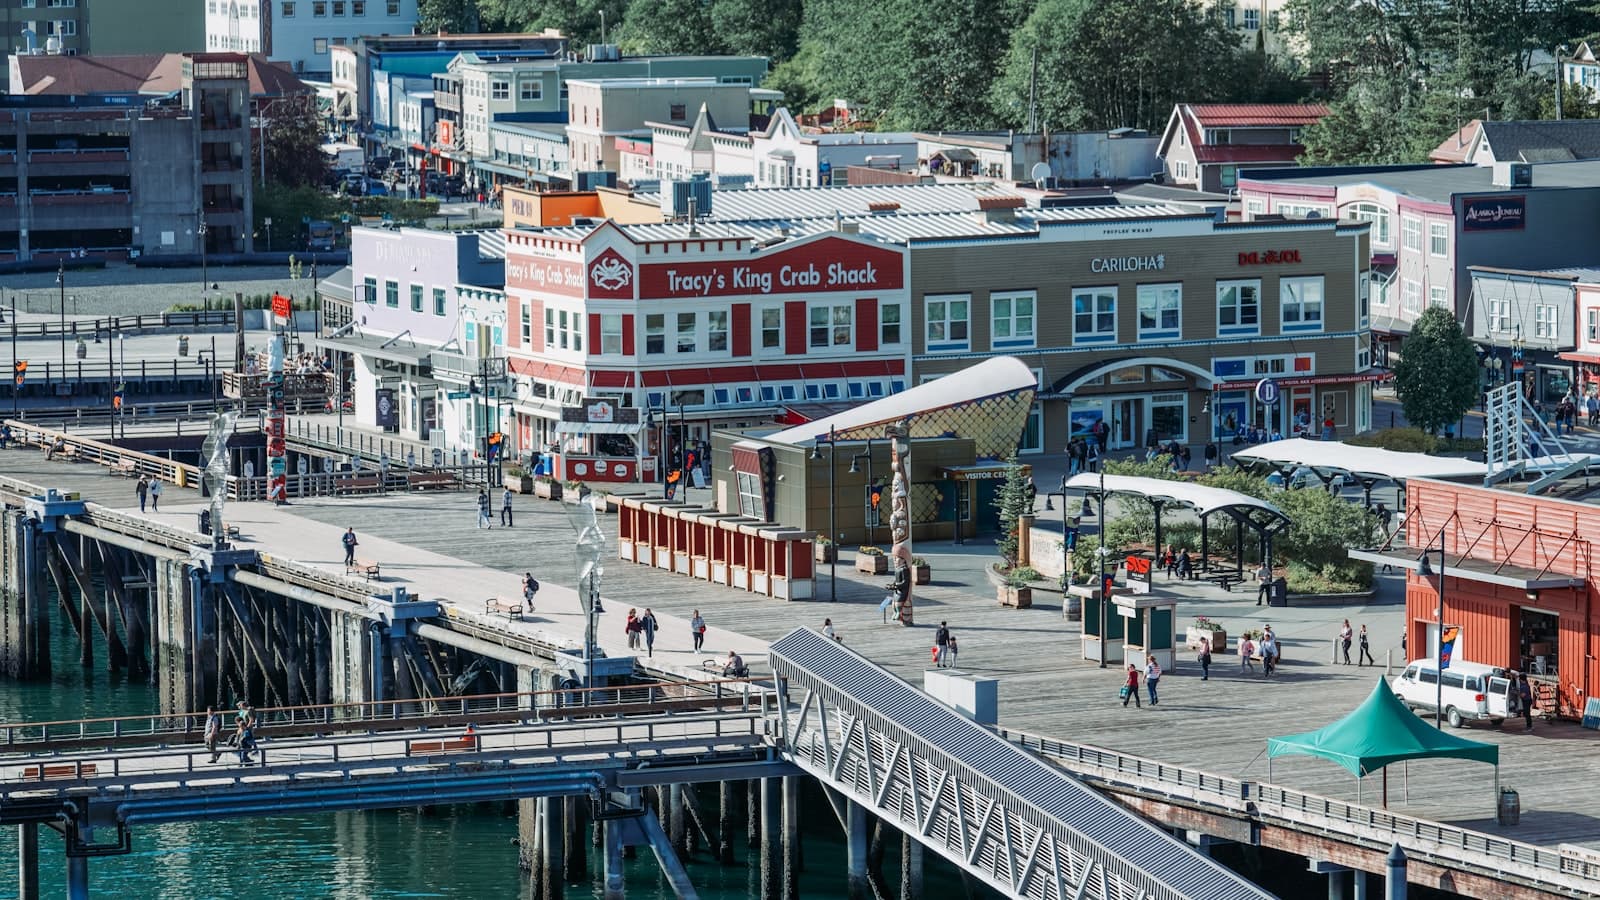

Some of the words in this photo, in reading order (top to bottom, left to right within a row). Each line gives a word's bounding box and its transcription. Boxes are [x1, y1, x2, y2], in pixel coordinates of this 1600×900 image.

[512, 198, 525, 216] PIER
[1091, 256, 1157, 273] CARILOHA
[507, 259, 528, 283] Tracy's
[530, 263, 545, 287] King
[546, 264, 563, 285] Crab
[564, 266, 584, 288] Shack
[666, 268, 726, 295] Tracy's
[733, 267, 772, 293] King
[779, 263, 821, 286] Crab
[827, 261, 877, 285] Shack
[1265, 384, 1274, 400] D
[965, 472, 992, 480] VISITOR
